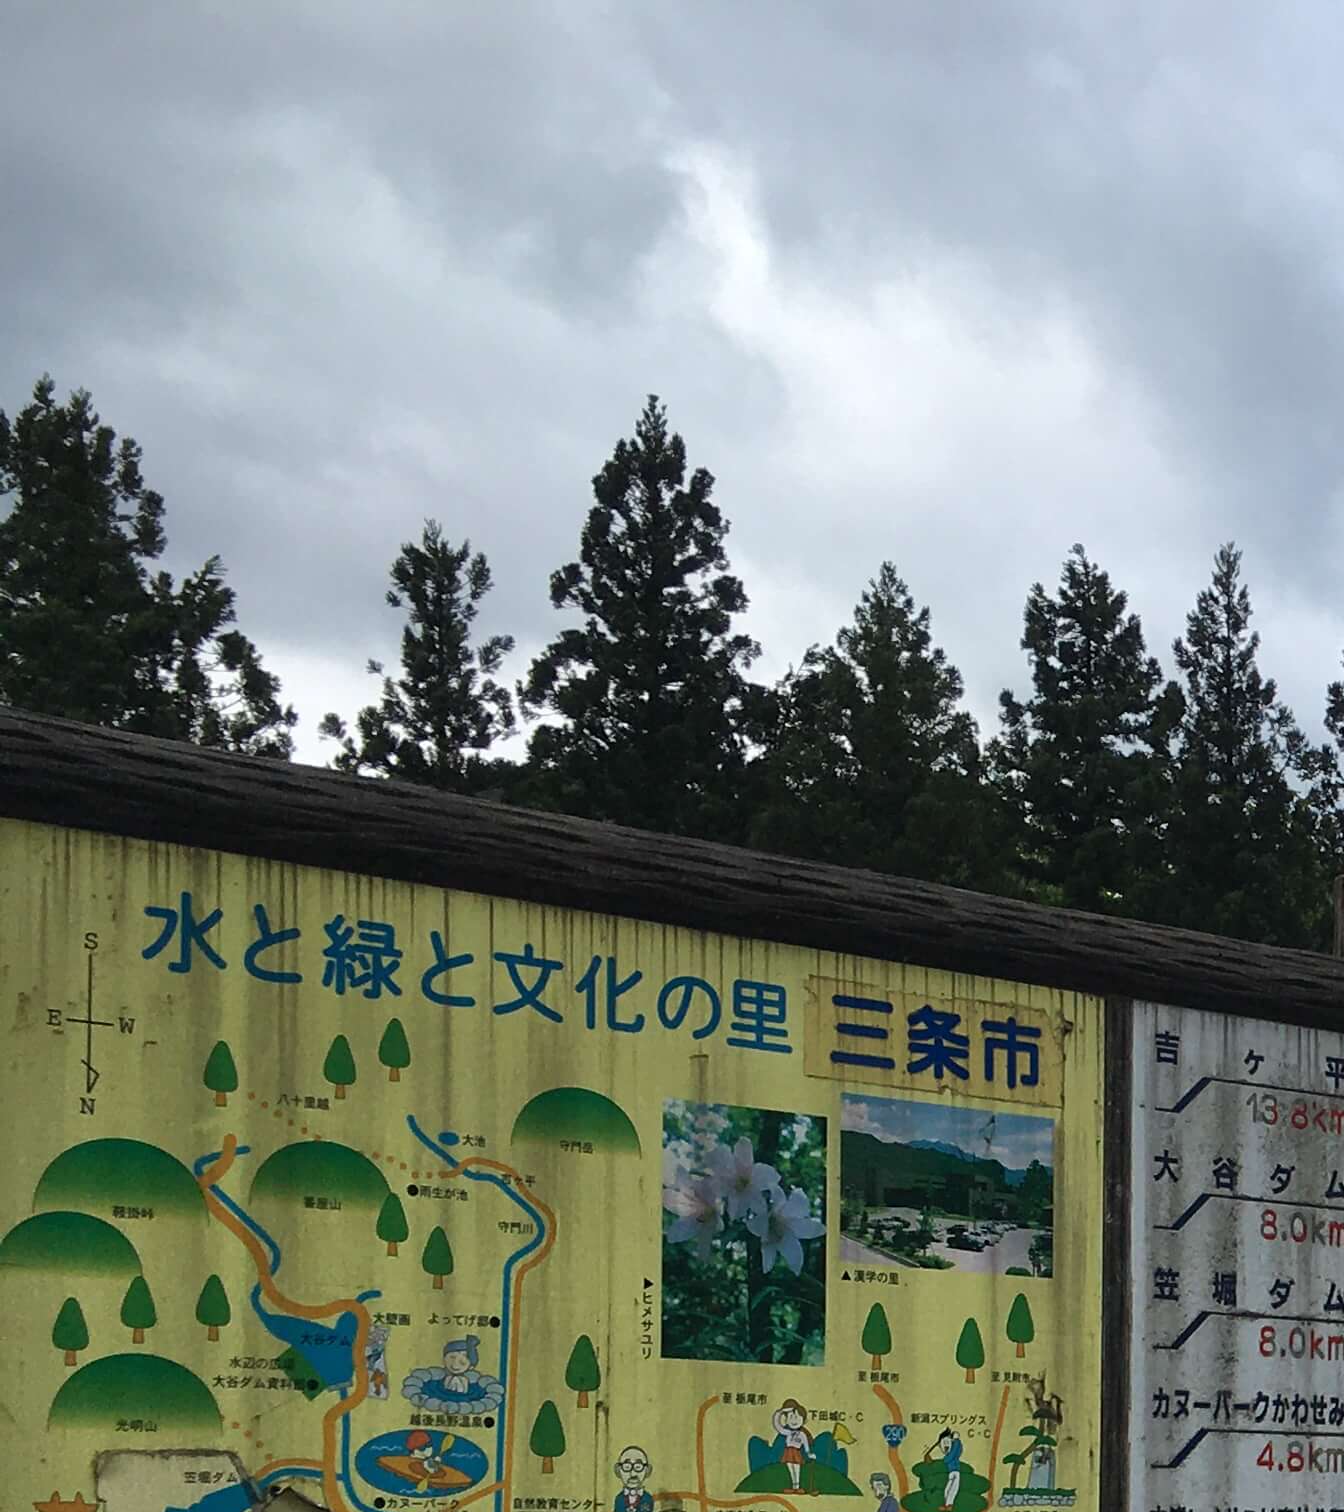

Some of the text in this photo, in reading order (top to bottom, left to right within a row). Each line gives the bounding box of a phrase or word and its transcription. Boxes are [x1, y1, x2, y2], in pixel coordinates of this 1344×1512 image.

[84, 933, 98, 950] S
[142, 891, 1042, 1088] 水と緑と文化の里 三条市
[47, 1009, 62, 1027] E
[117, 1017, 136, 1035] W
[79, 1098, 96, 1116] N
[462, 1134, 486, 1147] 大池
[854, 1269, 899, 1285] 漢学の里
[641, 1292, 653, 1359] ヒメサユリ
[301, 1334, 350, 1347] 大谷ダム
[513, 1496, 605, 1510] 自然教育センター
